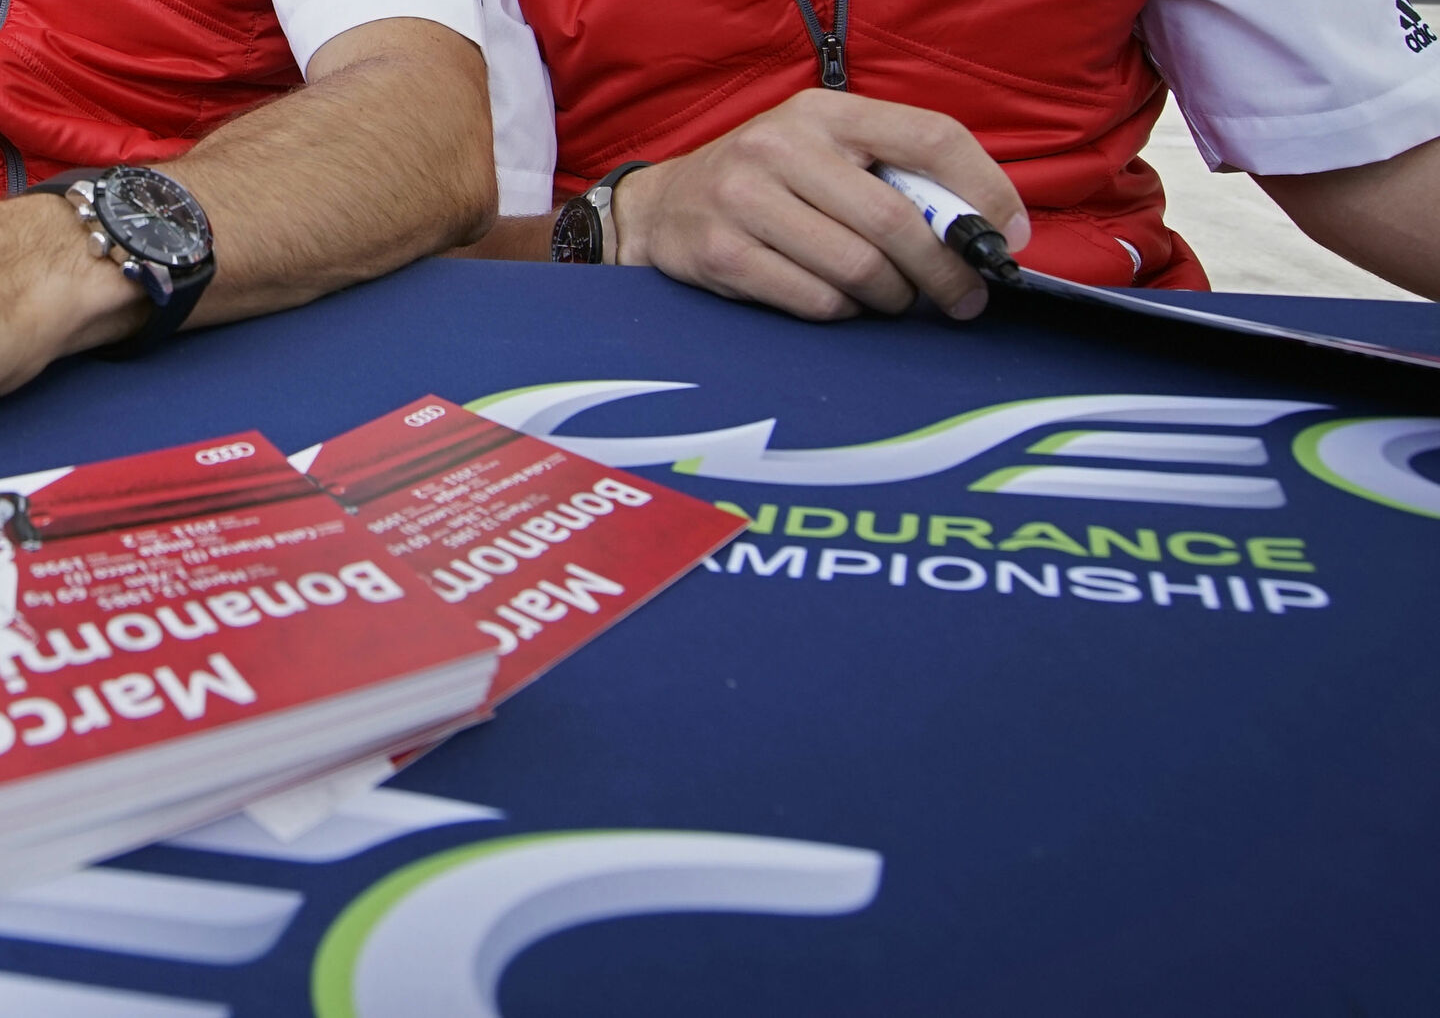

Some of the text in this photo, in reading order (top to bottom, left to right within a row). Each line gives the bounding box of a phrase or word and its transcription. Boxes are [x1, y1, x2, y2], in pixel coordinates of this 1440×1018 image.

[428, 477, 652, 603] Bonanom
[700, 541, 1331, 614] MPIONSHIP
[713, 500, 1317, 572] NDURANCE
[475, 562, 624, 655] Marc
